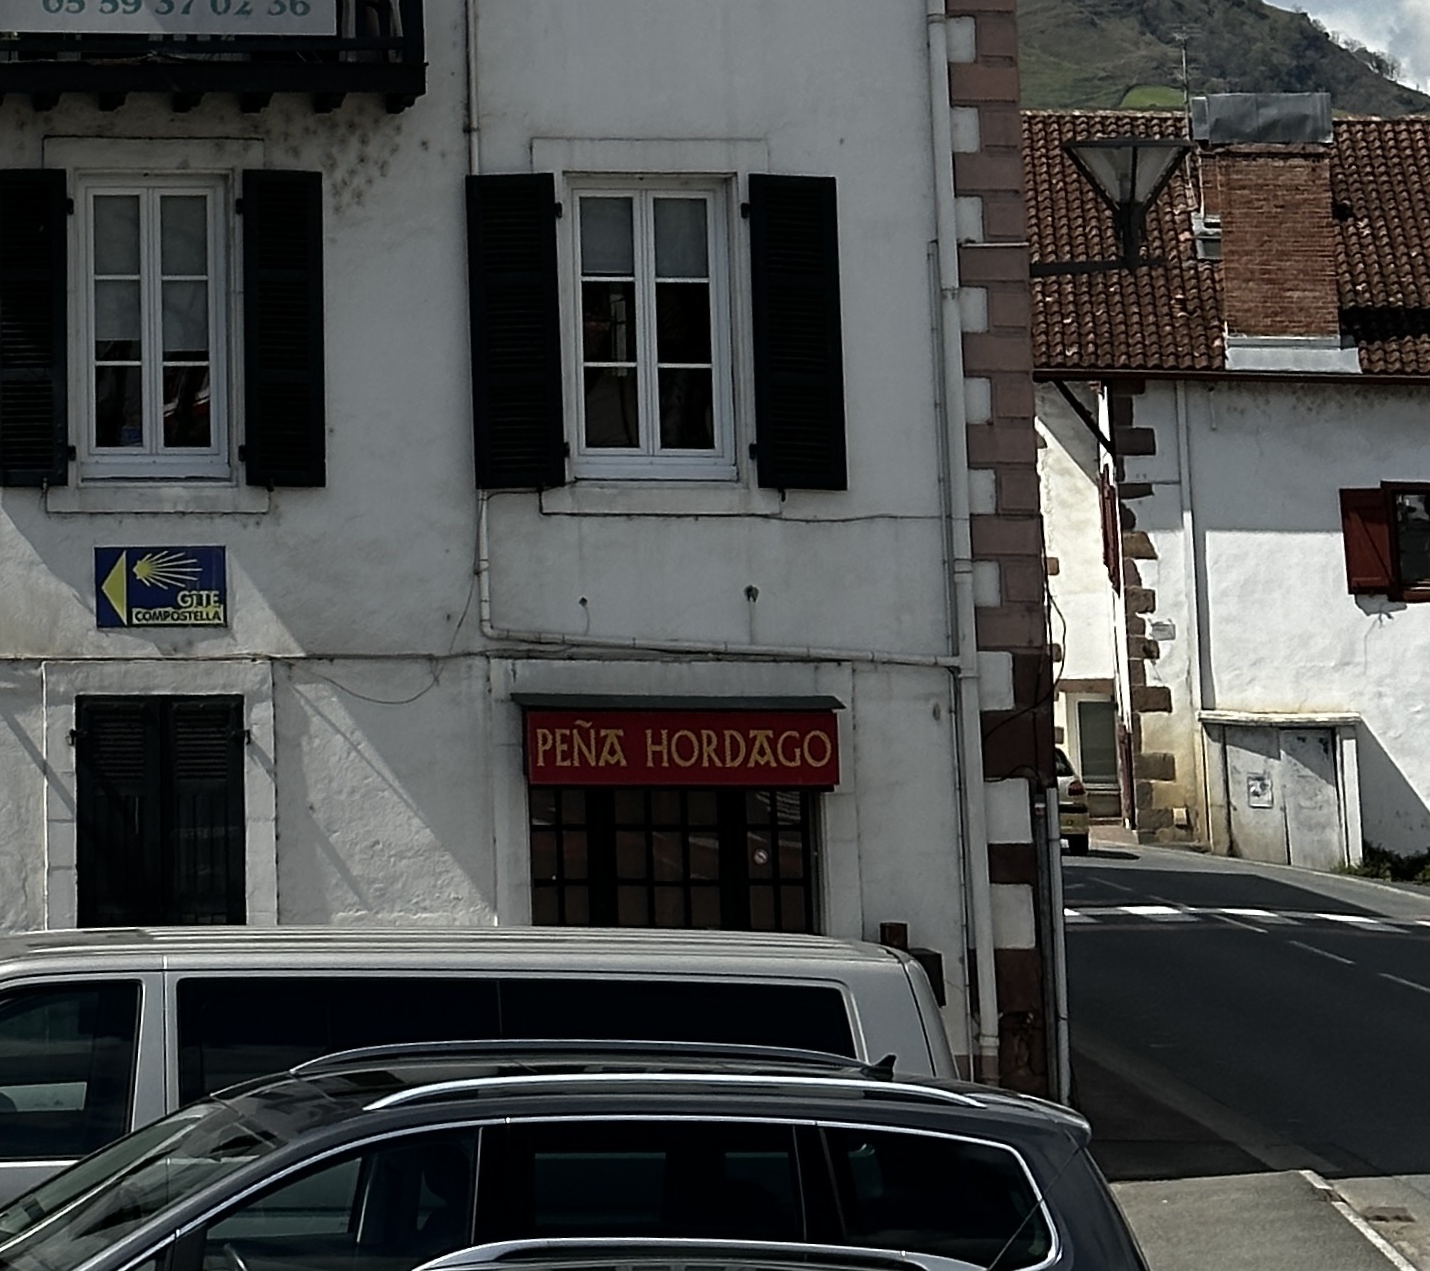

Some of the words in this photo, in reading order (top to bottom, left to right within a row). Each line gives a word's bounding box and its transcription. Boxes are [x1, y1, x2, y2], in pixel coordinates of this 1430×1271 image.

[134, 608, 221, 622] COMPOSTELLA
[536, 720, 627, 767] PEÑA
[645, 729, 832, 767] HORDAGO
